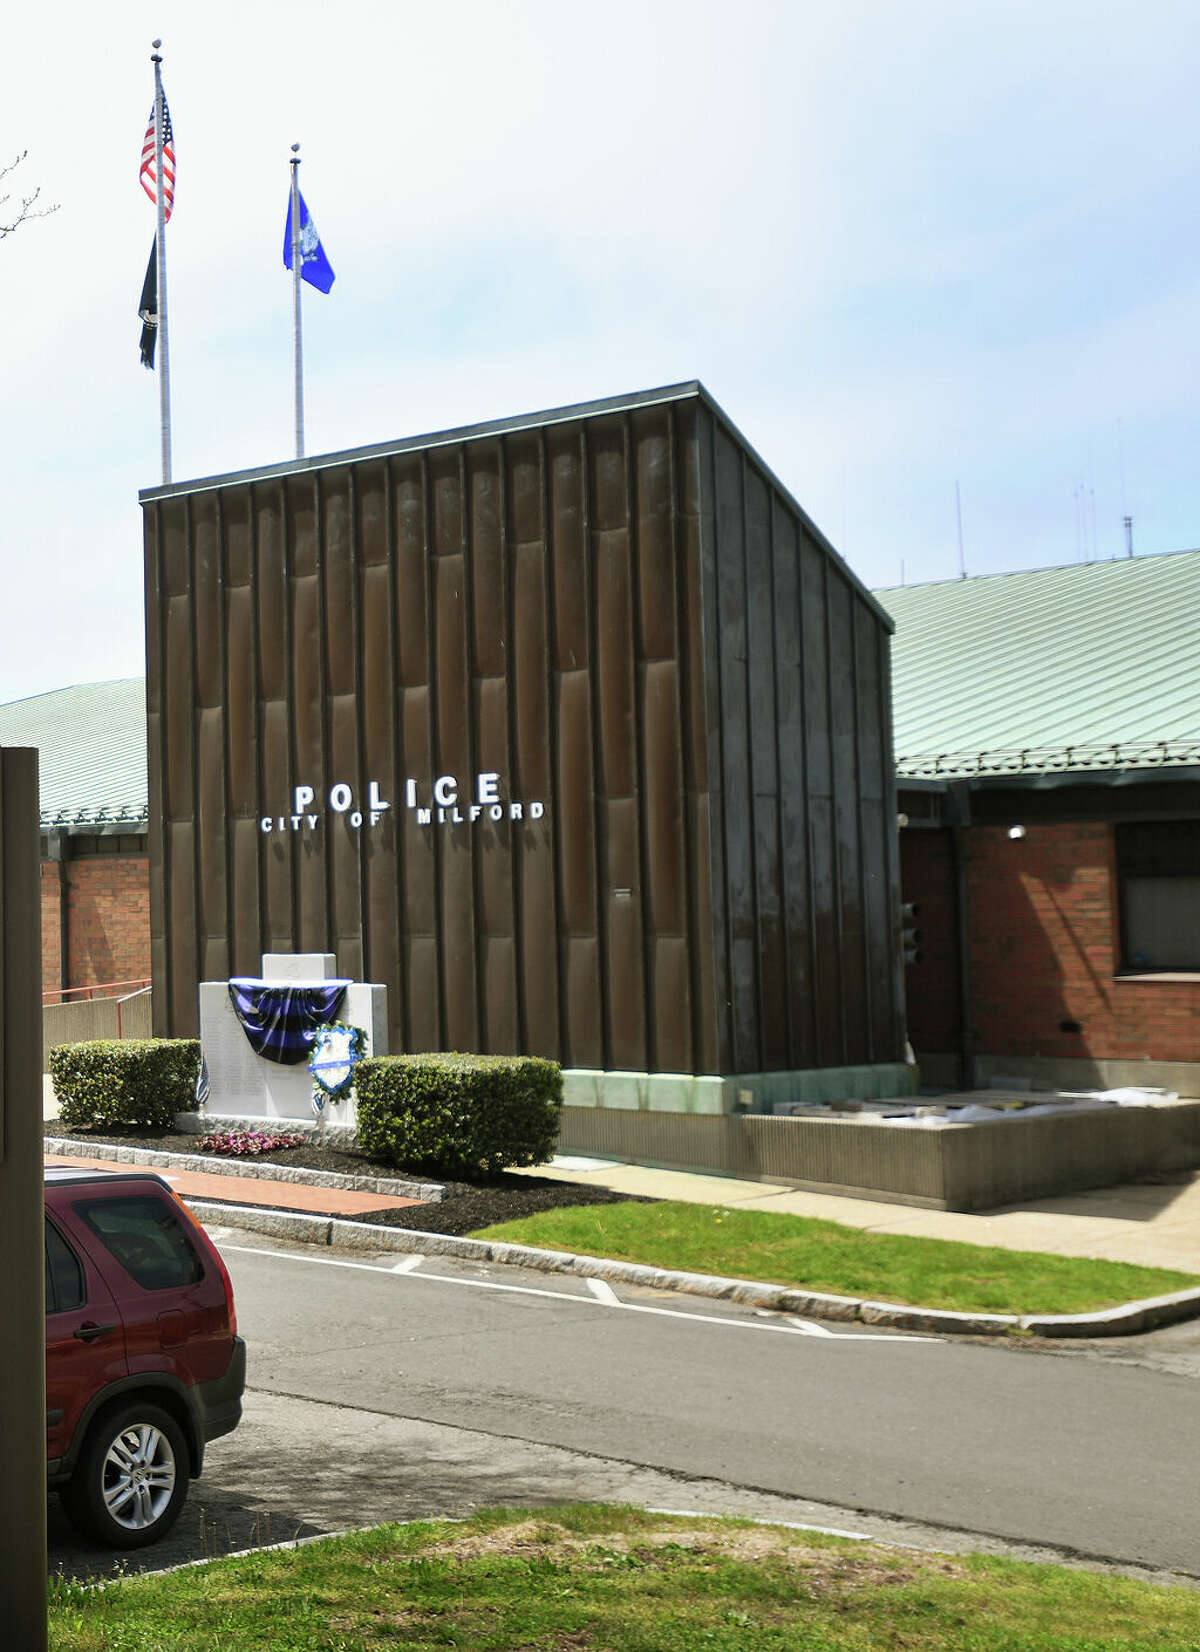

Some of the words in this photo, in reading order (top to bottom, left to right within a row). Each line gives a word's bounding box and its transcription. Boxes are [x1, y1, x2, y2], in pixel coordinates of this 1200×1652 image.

[294, 772, 501, 815] POLICE
[260, 814, 319, 833] CITY
[350, 811, 384, 828] OF
[416, 802, 544, 825] MILFORD
